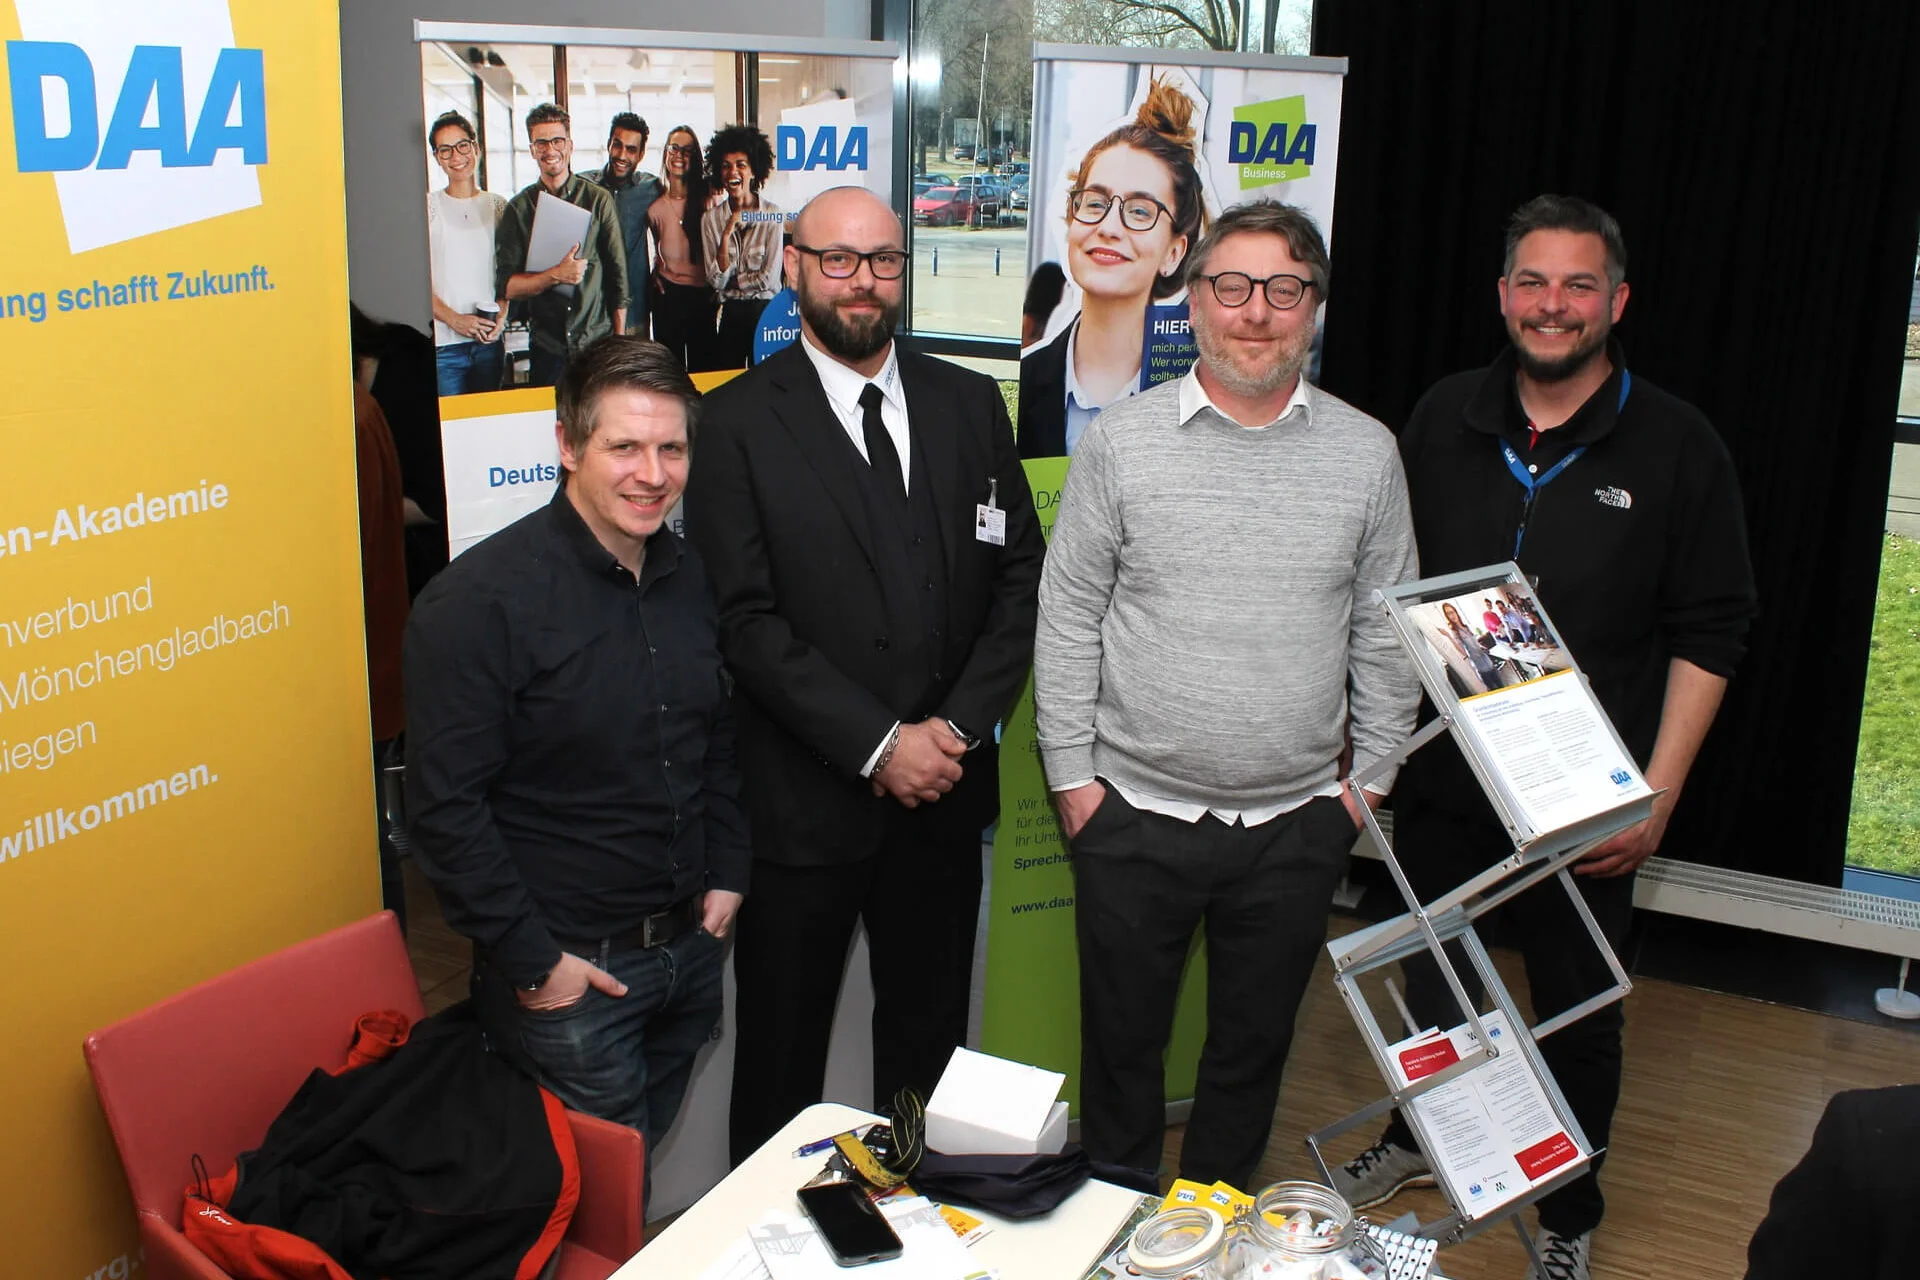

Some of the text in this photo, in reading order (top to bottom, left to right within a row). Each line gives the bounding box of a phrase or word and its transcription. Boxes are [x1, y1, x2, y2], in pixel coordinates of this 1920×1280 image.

[6, 40, 268, 173] DAA
[777, 126, 868, 171] DAA
[1228, 121, 1317, 165] DAA
[1243, 167, 1286, 179] Business
[741, 211, 783, 224] Bildung
[0, 264, 275, 323] ng schafft Zukunft.
[1153, 320, 1190, 335] HIER
[1151, 343, 1176, 353] mich
[1151, 357, 1171, 367] Wer
[1594, 488, 1621, 501] NORTH
[0, 600, 291, 713] Mönchengladbach
[1610, 770, 1632, 785] DAA
[1017, 798, 1037, 811] Wir
[1016, 816, 1032, 829] für
[1015, 834, 1031, 848] Ihr
